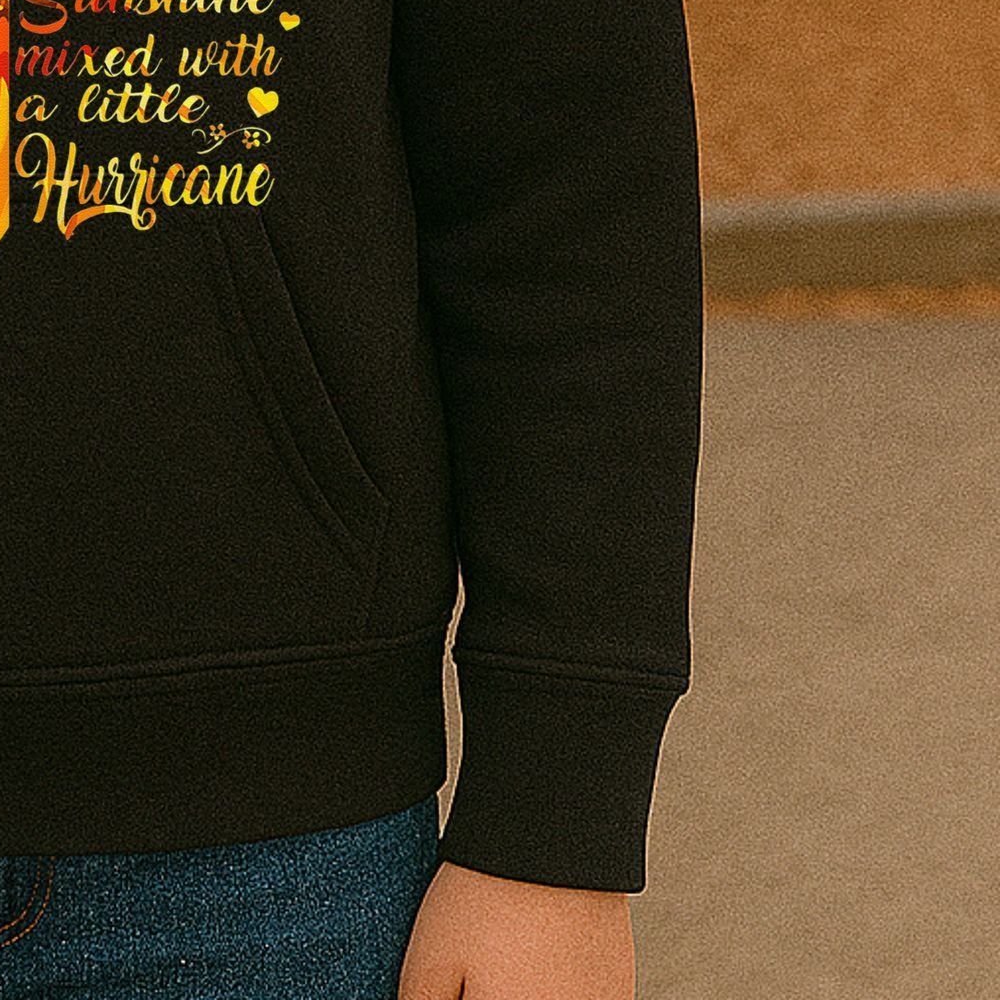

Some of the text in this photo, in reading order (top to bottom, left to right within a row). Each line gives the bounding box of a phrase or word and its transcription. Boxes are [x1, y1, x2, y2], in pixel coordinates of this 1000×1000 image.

[15, 33, 283, 77] mixed with
[15, 82, 210, 124] a little
[15, 132, 275, 240] Hurricane
